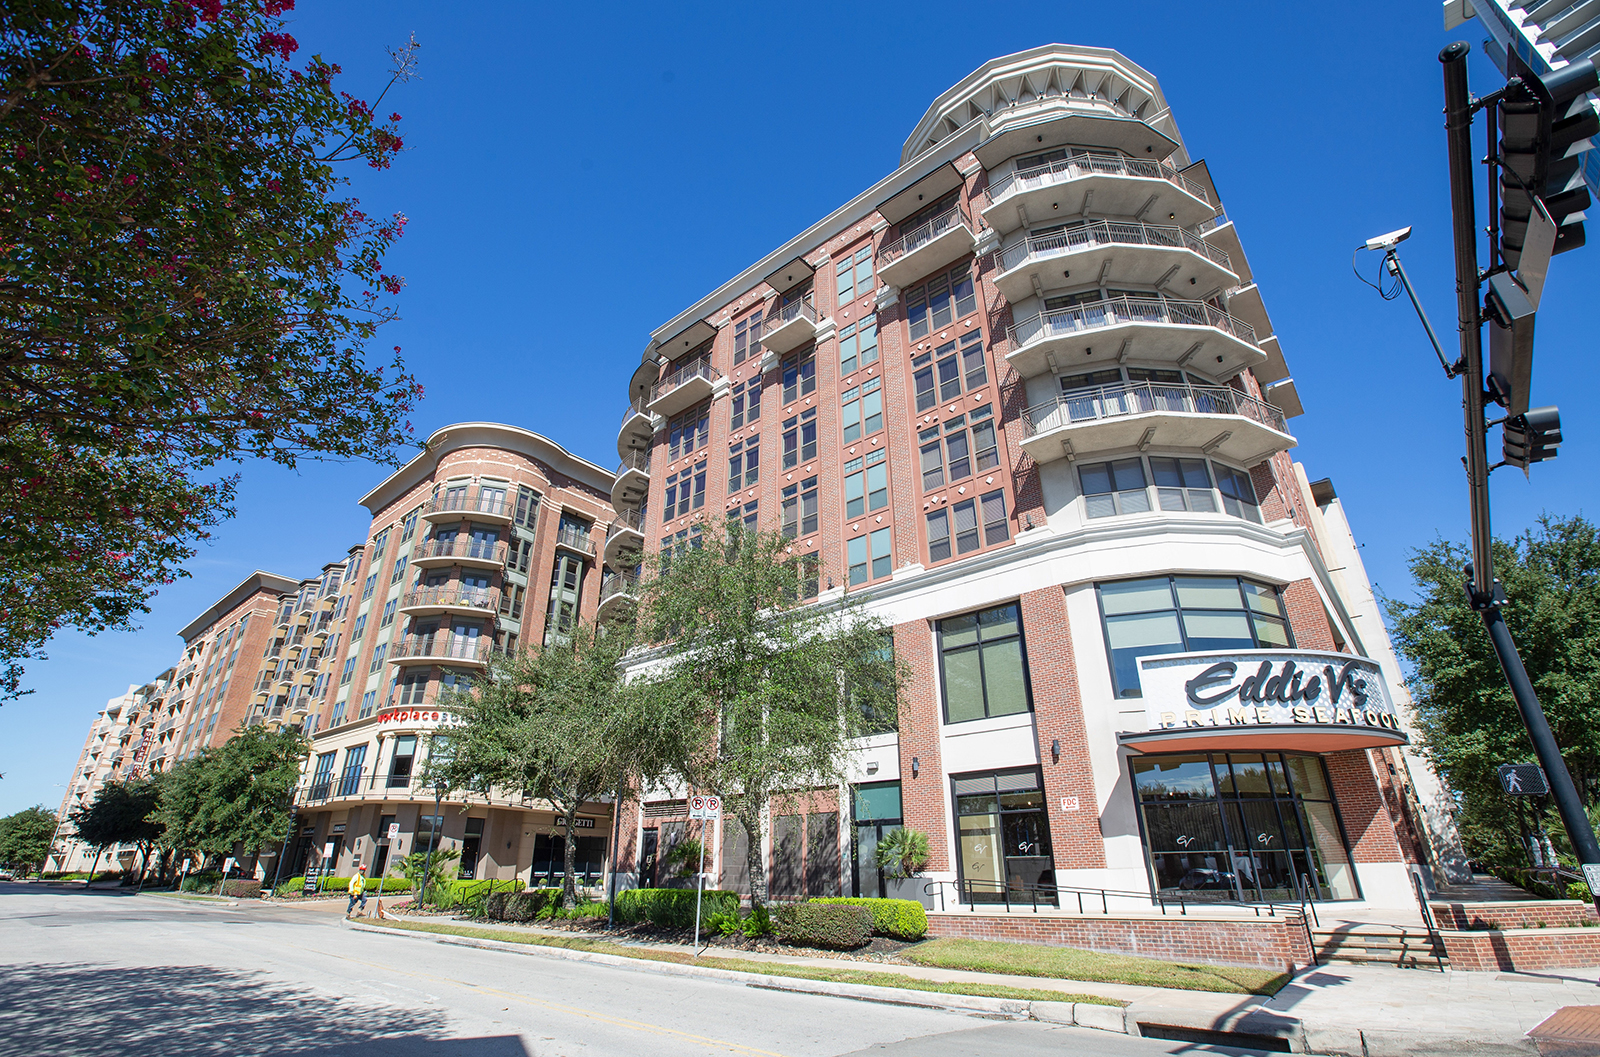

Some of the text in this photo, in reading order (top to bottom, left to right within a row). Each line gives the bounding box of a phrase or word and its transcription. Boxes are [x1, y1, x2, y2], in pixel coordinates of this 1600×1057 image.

[1186, 660, 1321, 705] Eddie
[1160, 706, 1401, 730] PRIME SEAFOOD
[1062, 798, 1077, 806] FDC
